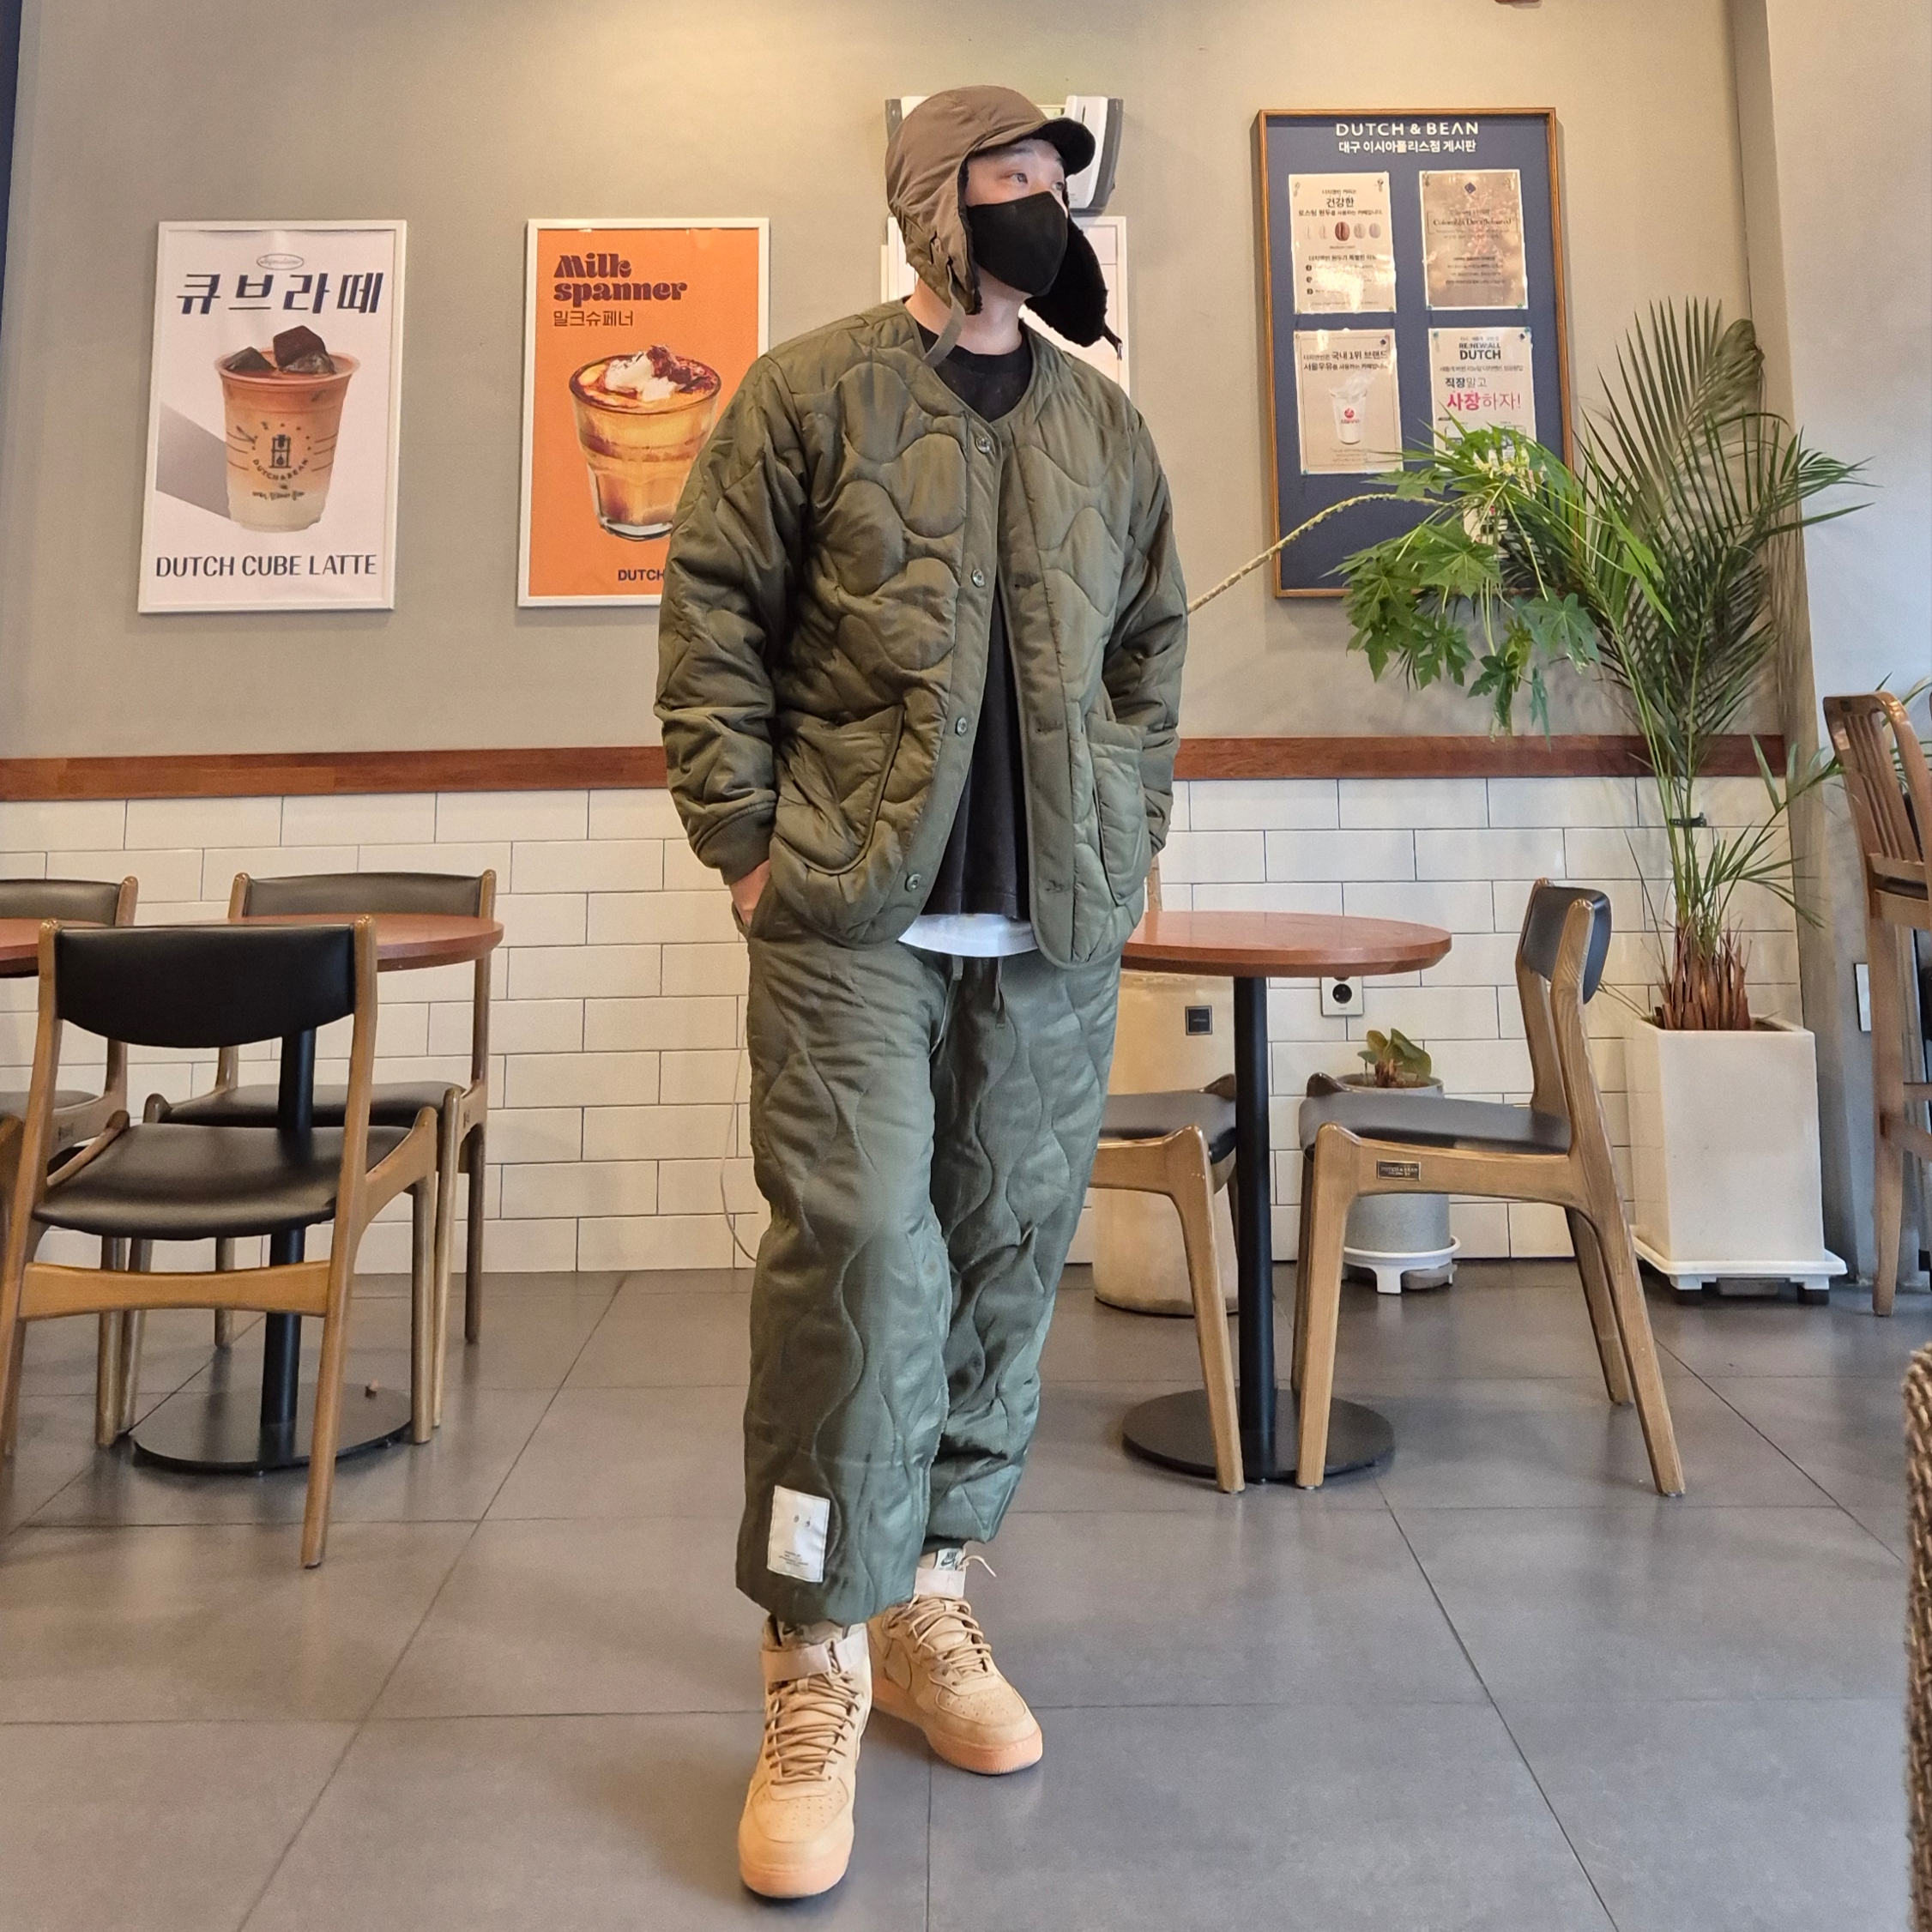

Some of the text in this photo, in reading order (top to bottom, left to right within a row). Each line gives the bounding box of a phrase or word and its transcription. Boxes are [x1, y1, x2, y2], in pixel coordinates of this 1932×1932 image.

[1335, 122, 1479, 136] DUTCH & BEAN
[1338, 141, 1361, 154] 대구
[1443, 139, 1476, 153] 게시판
[1326, 196, 1355, 208] 건강한
[553, 252, 632, 279] Milk
[176, 273, 383, 314] 큐브라떼
[553, 281, 688, 308] spanner
[553, 310, 634, 327] 밀크슈페너
[1331, 350, 1348, 360] 국내
[1459, 349, 1501, 360] DUTCH
[1445, 377, 1488, 389] 직장말고
[1446, 391, 1521, 411] 사장하자!
[156, 553, 377, 577] DUTCH CUBE LATTE
[618, 569, 665, 581] DUTCH
